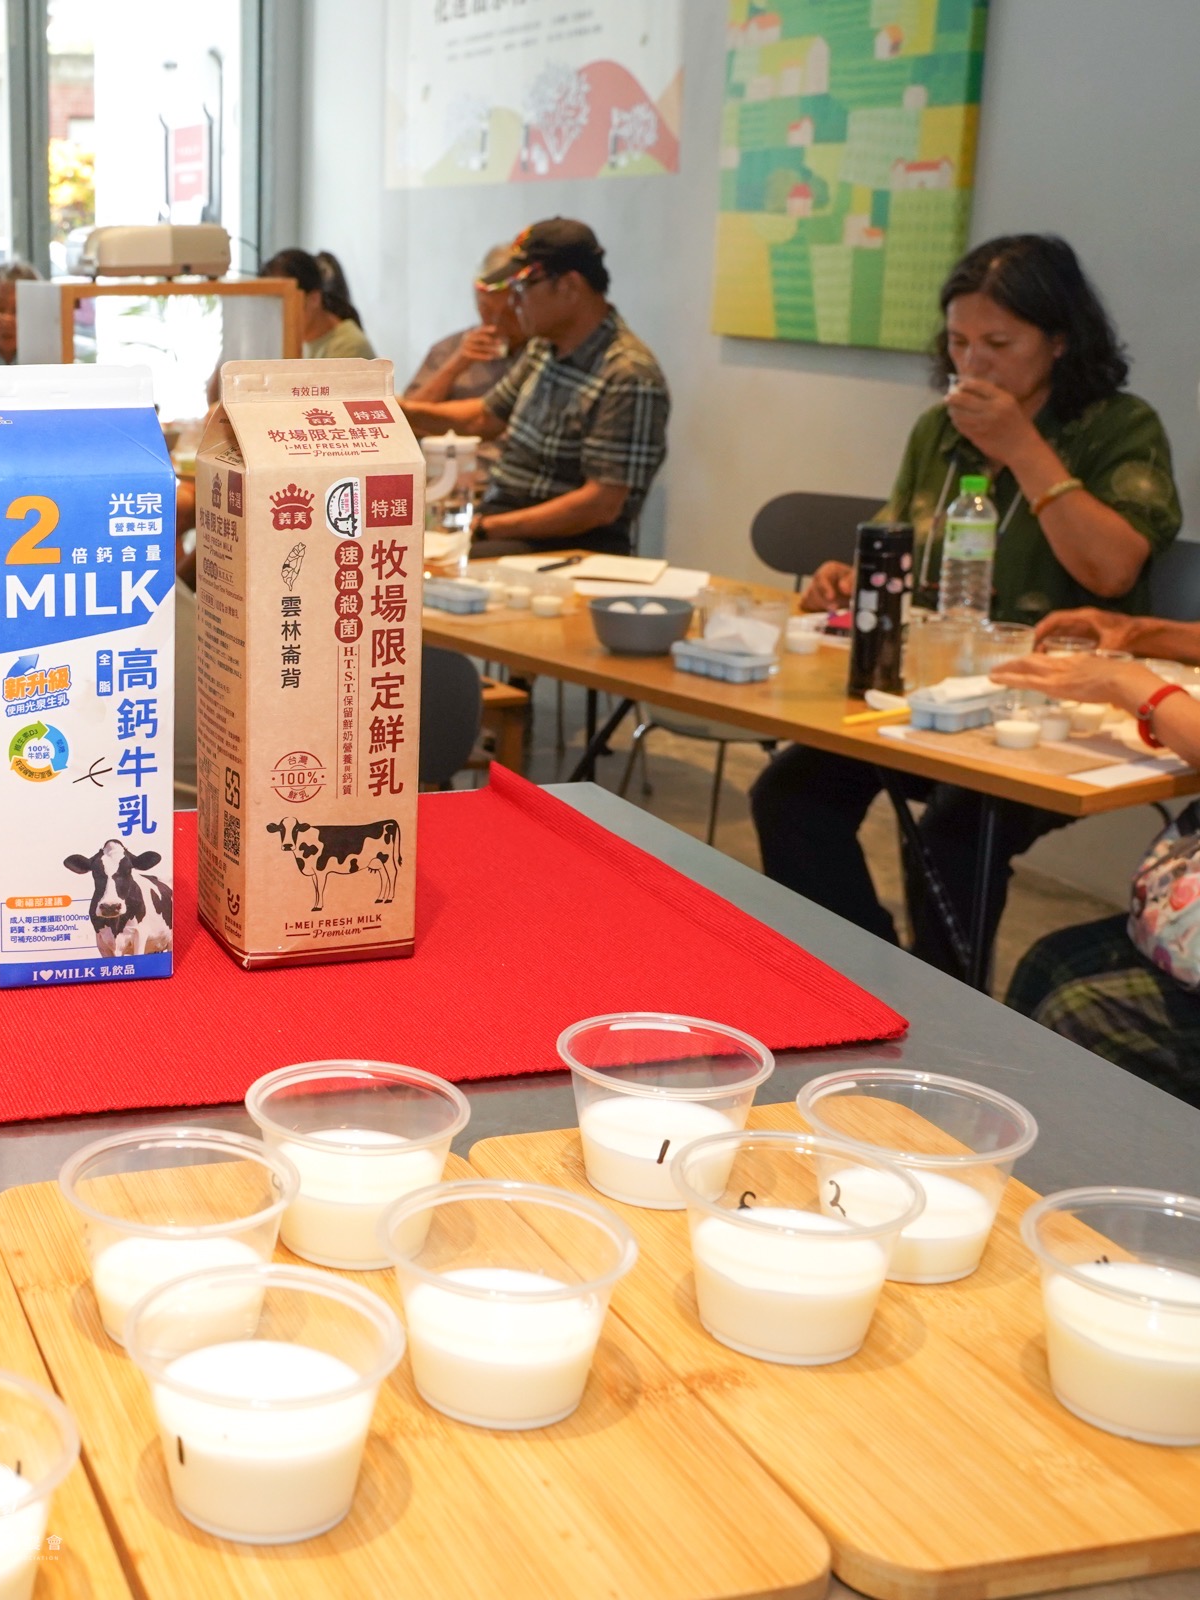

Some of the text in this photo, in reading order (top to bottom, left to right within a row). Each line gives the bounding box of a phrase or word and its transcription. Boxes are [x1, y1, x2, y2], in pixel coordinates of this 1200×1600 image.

[291, 386, 330, 397] 有效日期
[353, 409, 388, 421] 特選
[267, 427, 390, 443] 牧場限定鮮乳
[313, 449, 361, 458] Premium
[108, 492, 163, 515] 光泉
[371, 499, 408, 519] 特選
[115, 521, 158, 533] 營養牛乳
[278, 511, 308, 526] 義美
[5, 495, 61, 565] 2
[71, 545, 162, 564] 倍鈣含量
[6, 569, 159, 618] MILK
[339, 545, 359, 639] 速溫殺菌
[280, 596, 302, 689] 雲林崙背
[98, 653, 111, 693] 全脂
[368, 539, 408, 797] 牧場限定鮮乳
[3, 665, 72, 701] 新升級
[6, 693, 69, 717] 使用光泉生乳
[116, 647, 158, 836] 高鈣牛乳
[280, 771, 318, 786] 100%
[287, 791, 310, 800] 鮮乳
[284, 914, 383, 931] I-MEI FRESH MILK
[313, 927, 362, 939] Premium
[55, 967, 96, 980] MILK
[99, 964, 136, 978] 乳飲品
